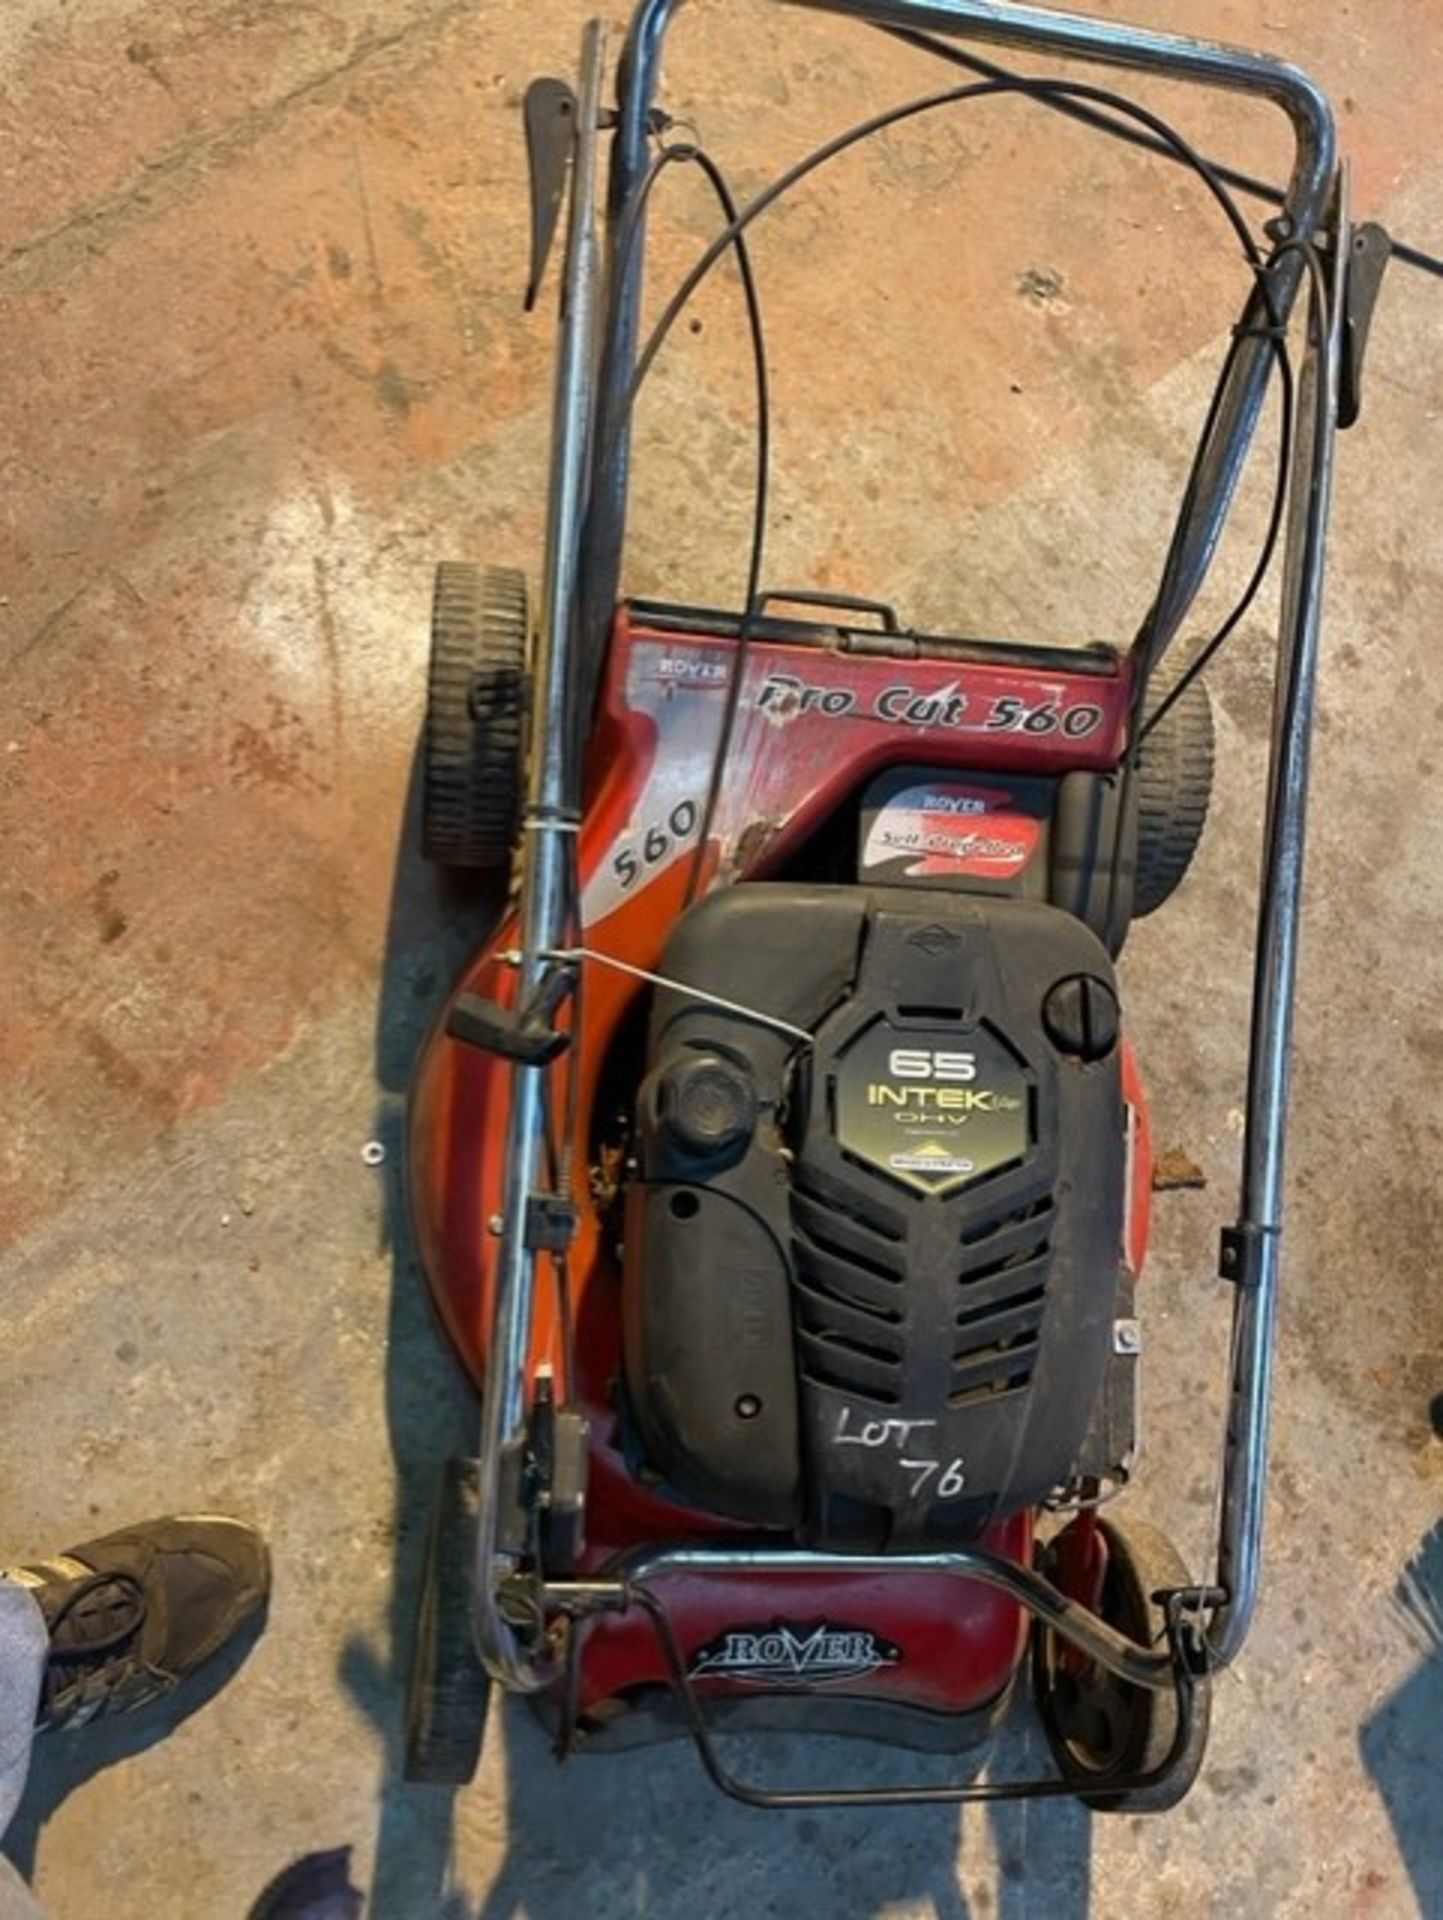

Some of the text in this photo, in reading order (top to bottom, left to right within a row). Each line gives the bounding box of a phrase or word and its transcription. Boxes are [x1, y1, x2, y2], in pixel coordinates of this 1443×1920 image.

[757, 676, 1103, 738] Pro Cut 560
[923, 795, 986, 814] ROVER
[613, 799, 697, 889] 560
[889, 1048, 976, 1081] 65
[867, 1083, 993, 1111] INTEK
[892, 1111, 969, 1125] OHV
[832, 1407, 937, 1449] LOT
[899, 1457, 964, 1498] 76
[724, 1625, 880, 1673] ROVER
